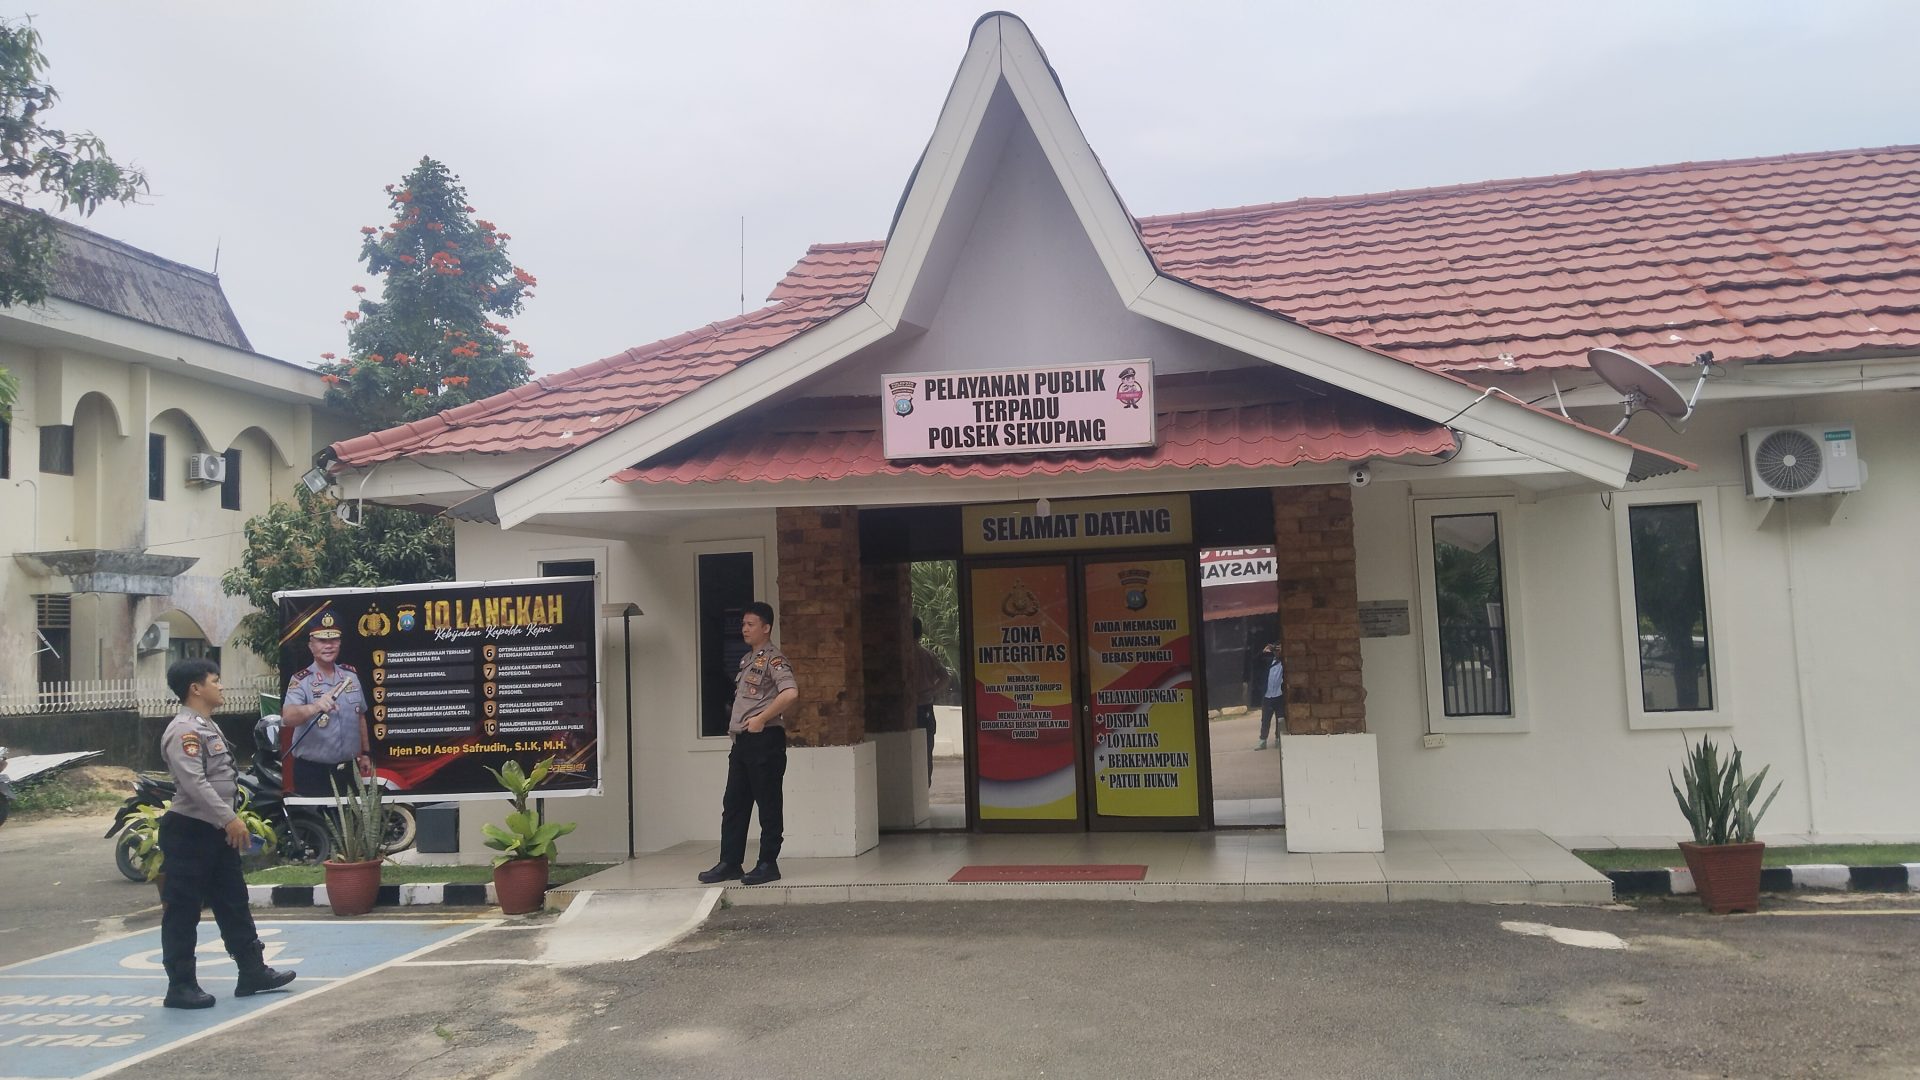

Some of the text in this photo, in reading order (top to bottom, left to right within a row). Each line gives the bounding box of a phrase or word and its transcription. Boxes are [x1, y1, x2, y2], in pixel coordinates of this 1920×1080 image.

[925, 373, 1032, 400] PELAYANAN
[1036, 369, 1105, 394] PUBLIK
[973, 397, 1059, 422] TERPADU
[929, 419, 1105, 449] POLSEK SEKUPANG
[983, 508, 1170, 541] SELAMAT DATANG
[425, 594, 563, 630] 10 LANGKAH
[434, 624, 552, 642] Kebijakan Kapolda Kepri
[1094, 620, 1176, 632] ANDA MEMASUKI
[1002, 627, 1041, 643] ZONA
[1112, 636, 1160, 647] KAWASAN
[378, 654, 381, 662] 1
[979, 645, 1065, 663] INTEGRITAS
[1102, 651, 1171, 663] BEBAS PUNGLI
[487, 668, 492, 676] 7
[377, 691, 382, 699] 3
[1098, 691, 1140, 704] MELAYANI
[1142, 690, 1177, 703] DENGAN
[487, 705, 493, 713] 9
[486, 724, 495, 732] 10
[1106, 713, 1148, 728] DISIPLIN
[378, 728, 383, 736] 5
[1107, 733, 1158, 748] LOYALITAS
[390, 746, 412, 756] Irjen
[415, 745, 431, 755] Pol
[434, 745, 460, 755] Asep
[515, 742, 541, 752] S.I.K,
[543, 741, 566, 750] M.H.
[1108, 753, 1188, 768] BERKEMAMPUAN
[1109, 773, 1177, 788] PATUH HUKUM
[0, 1034, 146, 1047] ITAS
